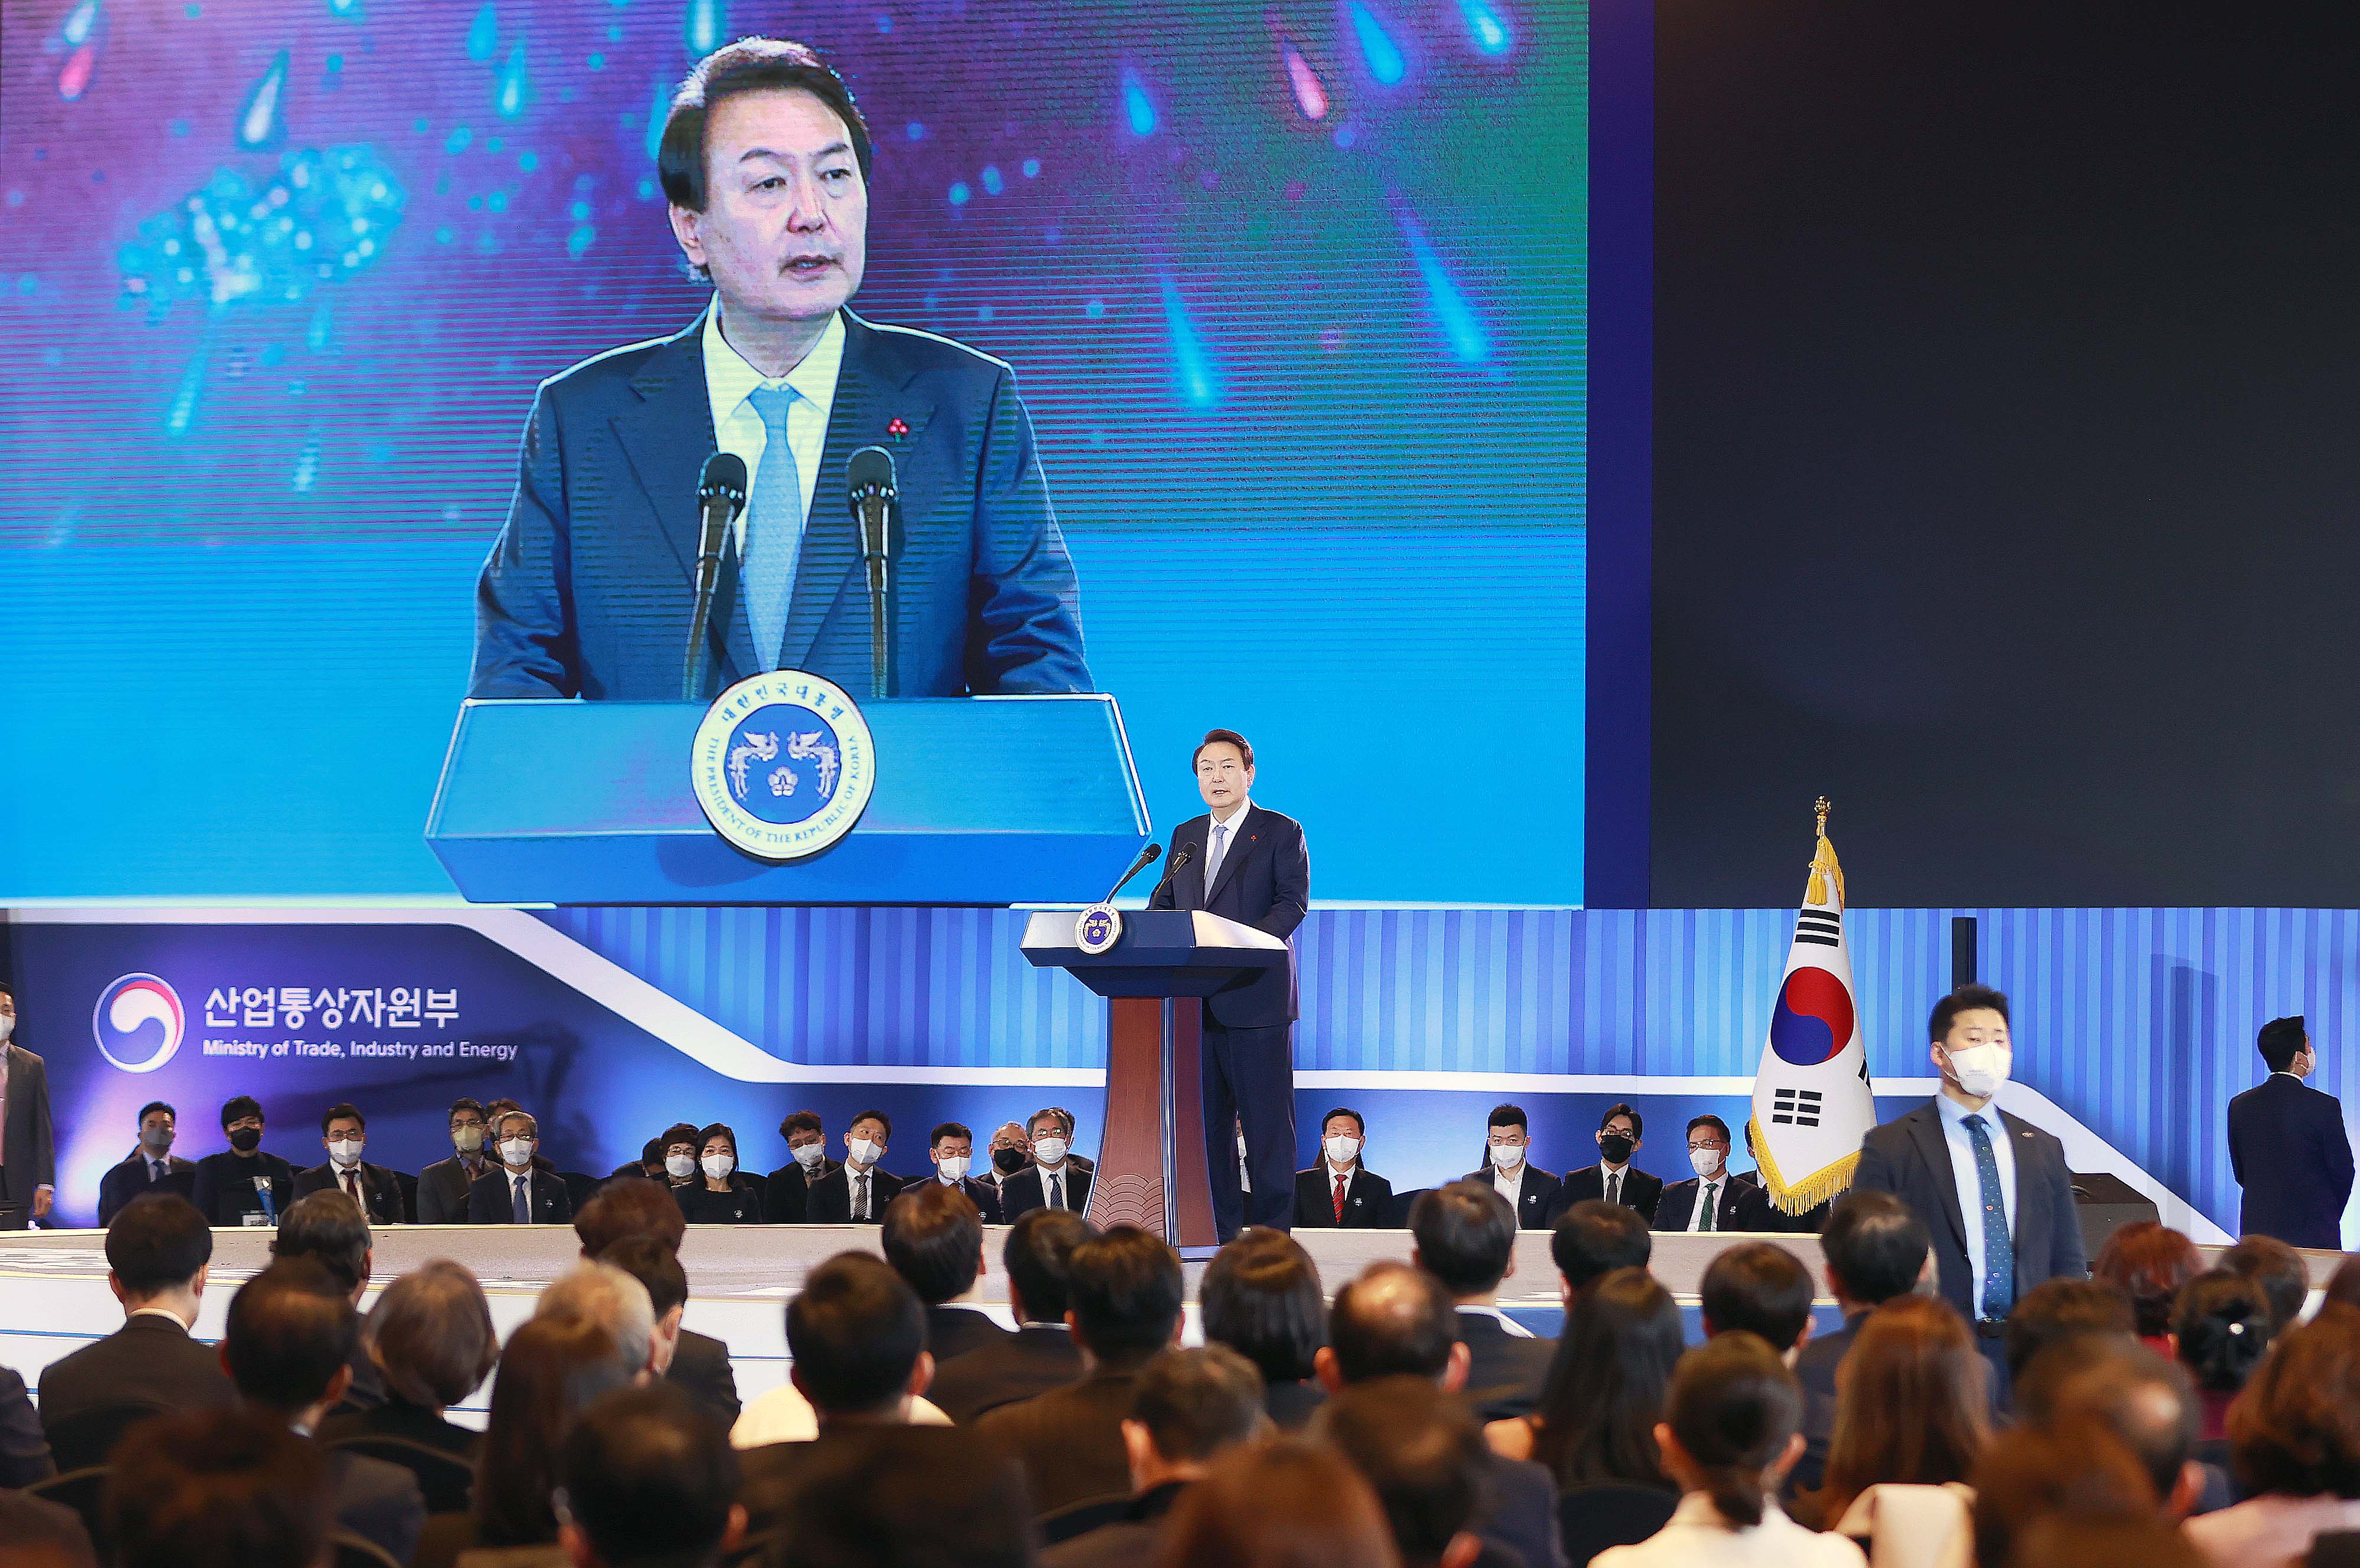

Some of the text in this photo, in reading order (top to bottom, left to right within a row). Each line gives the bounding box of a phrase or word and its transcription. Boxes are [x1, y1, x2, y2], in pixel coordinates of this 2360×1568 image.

[746, 826, 762, 839] OF
[767, 830, 791, 843] THE
[204, 986, 460, 1030] 산업통상자원부
[202, 1039, 518, 1062] Ministry of Trade, Industry and Energy
